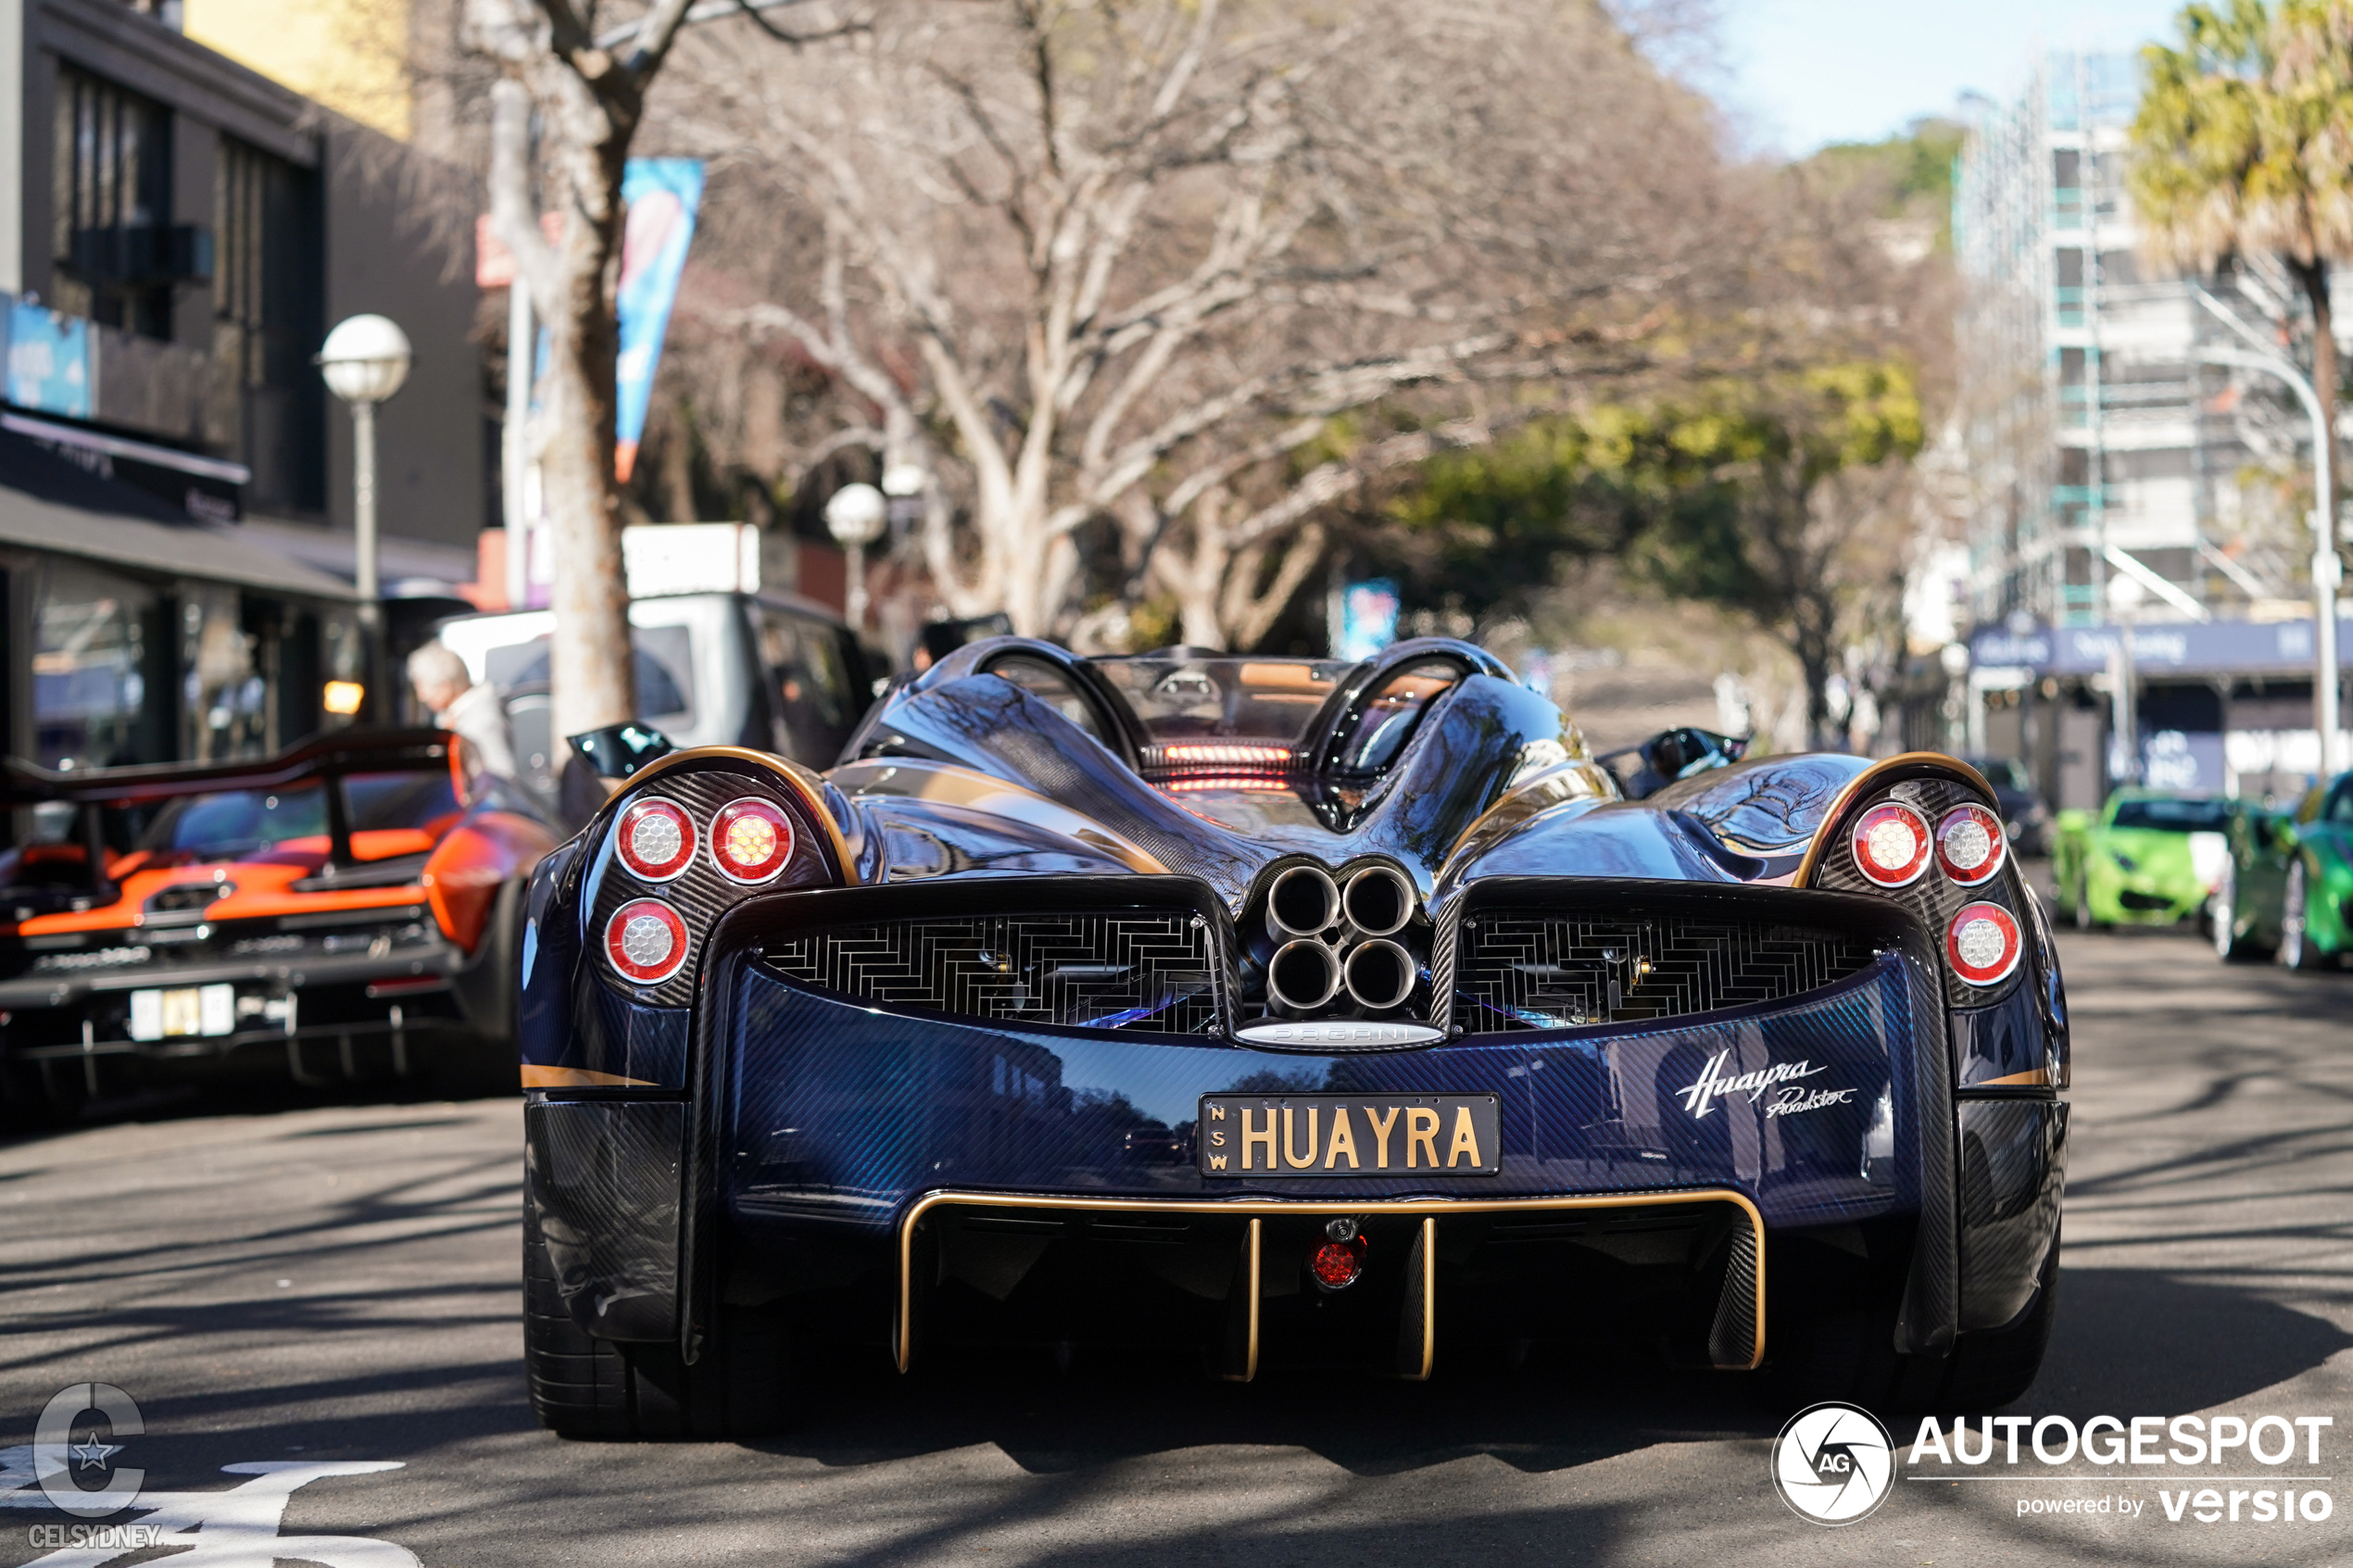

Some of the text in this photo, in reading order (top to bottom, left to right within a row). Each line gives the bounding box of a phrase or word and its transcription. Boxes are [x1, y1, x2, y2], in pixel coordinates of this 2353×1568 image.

[1273, 1028, 1411, 1041] PAGANI
[1675, 1047, 1829, 1120] Huayra
[1766, 1086, 1858, 1119] Roadster
[1239, 1106, 1482, 1170] HUAYRA
